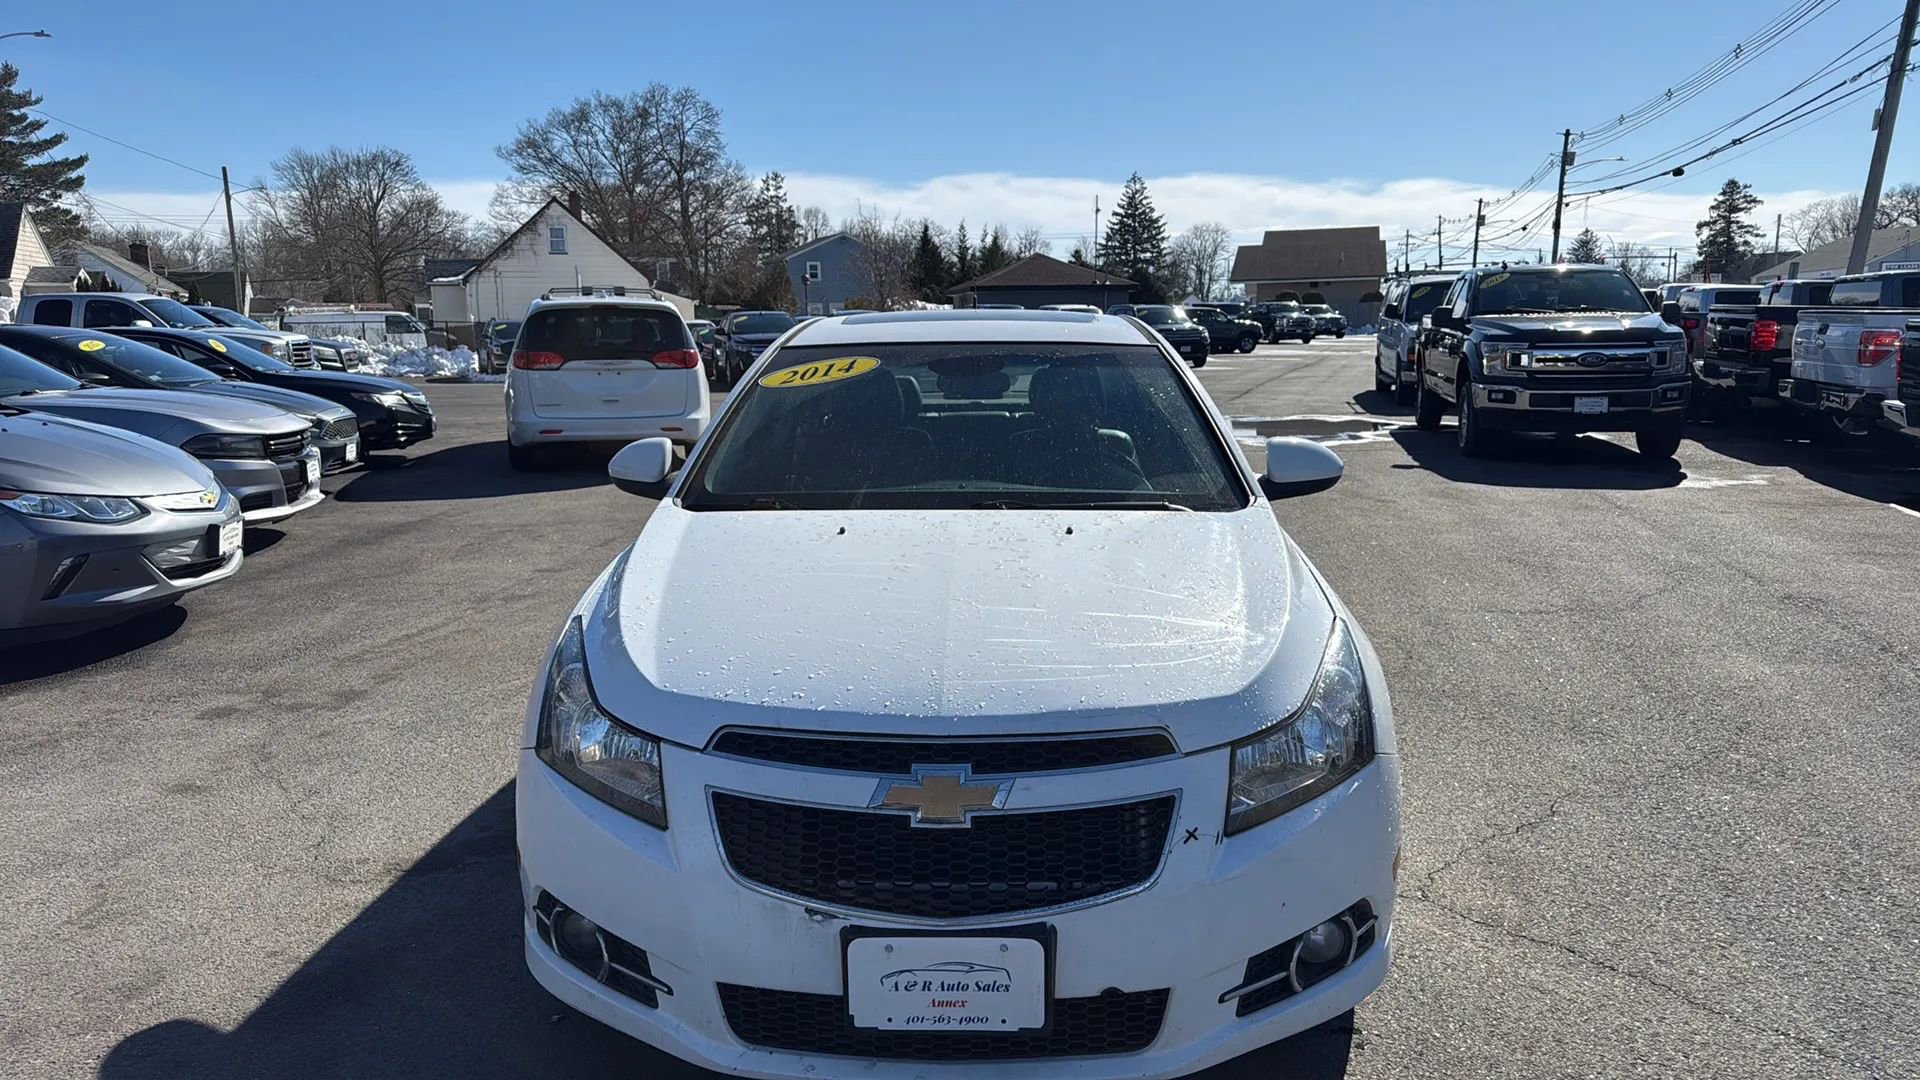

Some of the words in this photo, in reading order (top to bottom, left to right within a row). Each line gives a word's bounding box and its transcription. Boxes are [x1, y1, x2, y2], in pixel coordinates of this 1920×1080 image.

[779, 358, 859, 385] 2014
[888, 980, 899, 993] A
[904, 980, 919, 992] &
[921, 981, 932, 992] R
[935, 980, 969, 993] Auto
[973, 980, 1011, 993] Sales
[928, 997, 968, 1008] Annex
[905, 1013, 989, 1025] 401-563-4900
